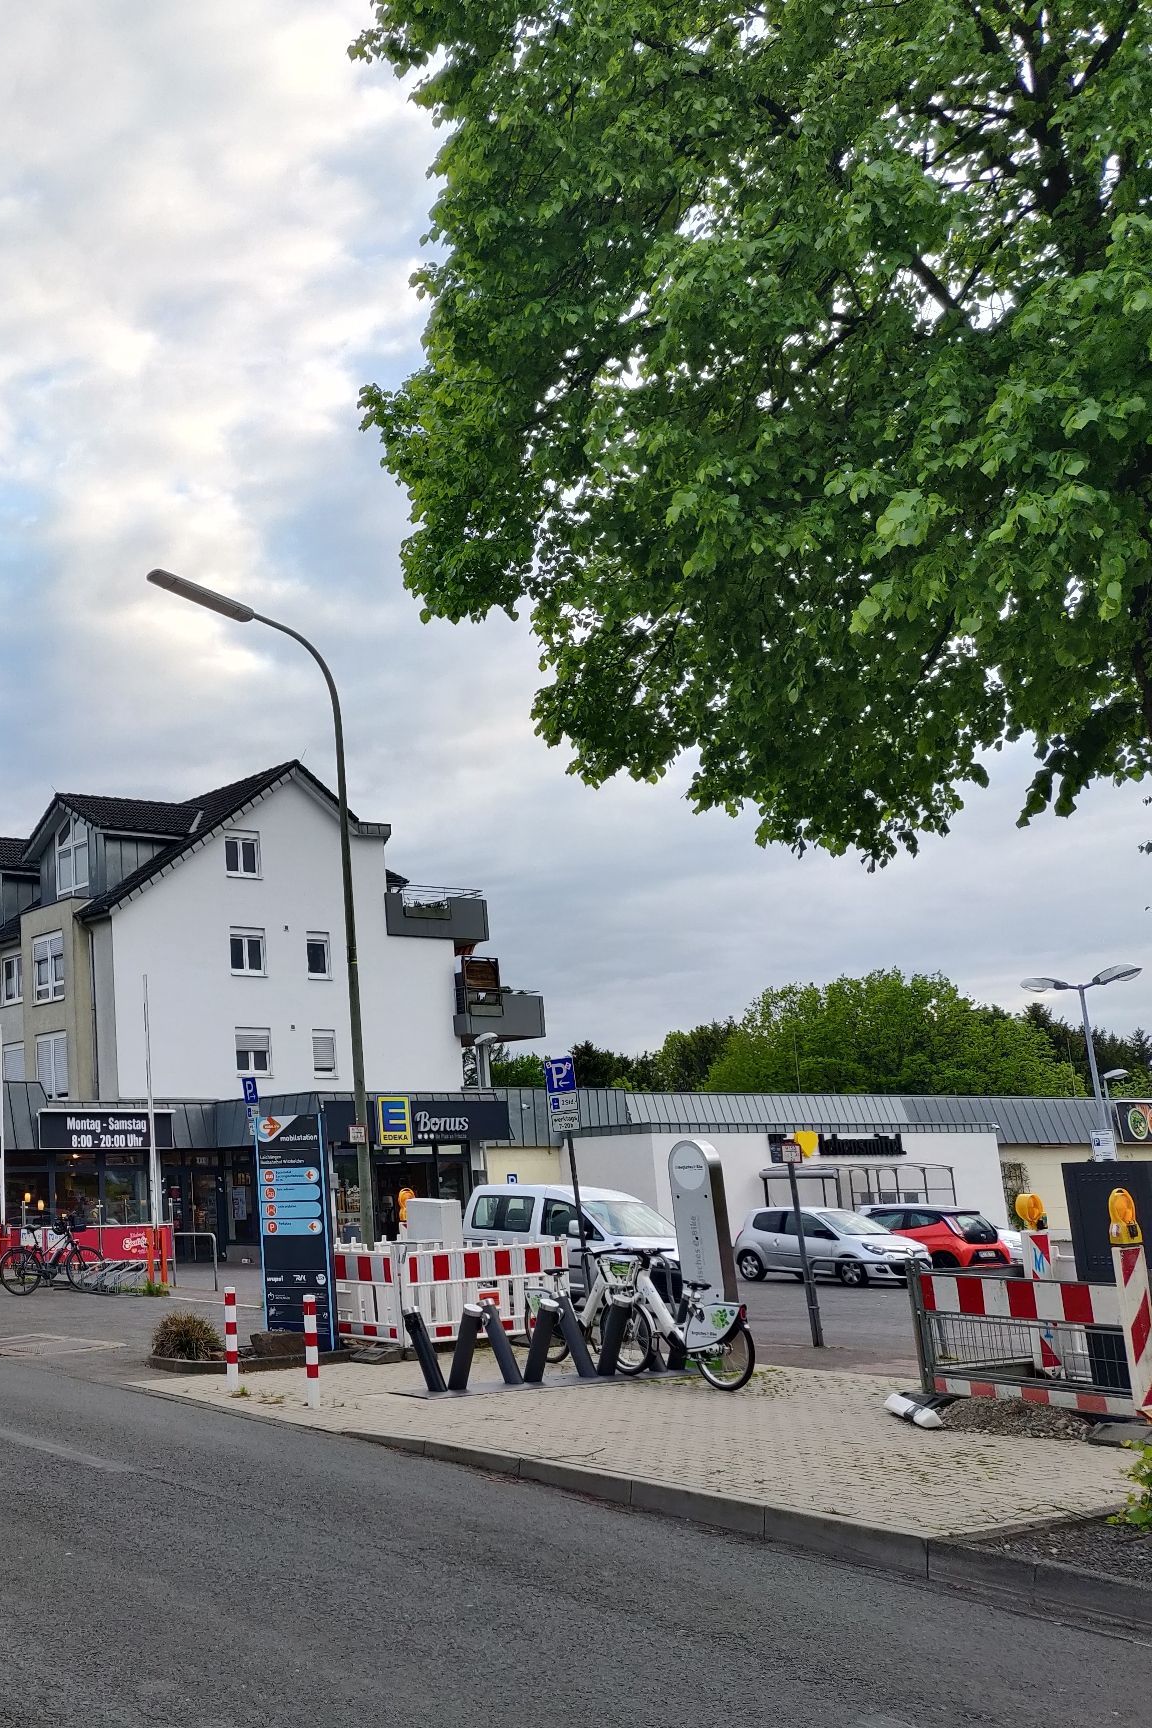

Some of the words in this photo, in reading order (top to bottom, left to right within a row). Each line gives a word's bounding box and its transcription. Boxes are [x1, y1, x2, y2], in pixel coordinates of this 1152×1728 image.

[66, 1116, 101, 1133] Montag
[108, 1117, 147, 1133] Samstag
[414, 1110, 469, 1132] Bonus
[71, 1134, 93, 1147] 8:00
[99, 1134, 126, 1148] 20:00
[127, 1133, 144, 1147] Uhr
[279, 1133, 318, 1142] mobilstation
